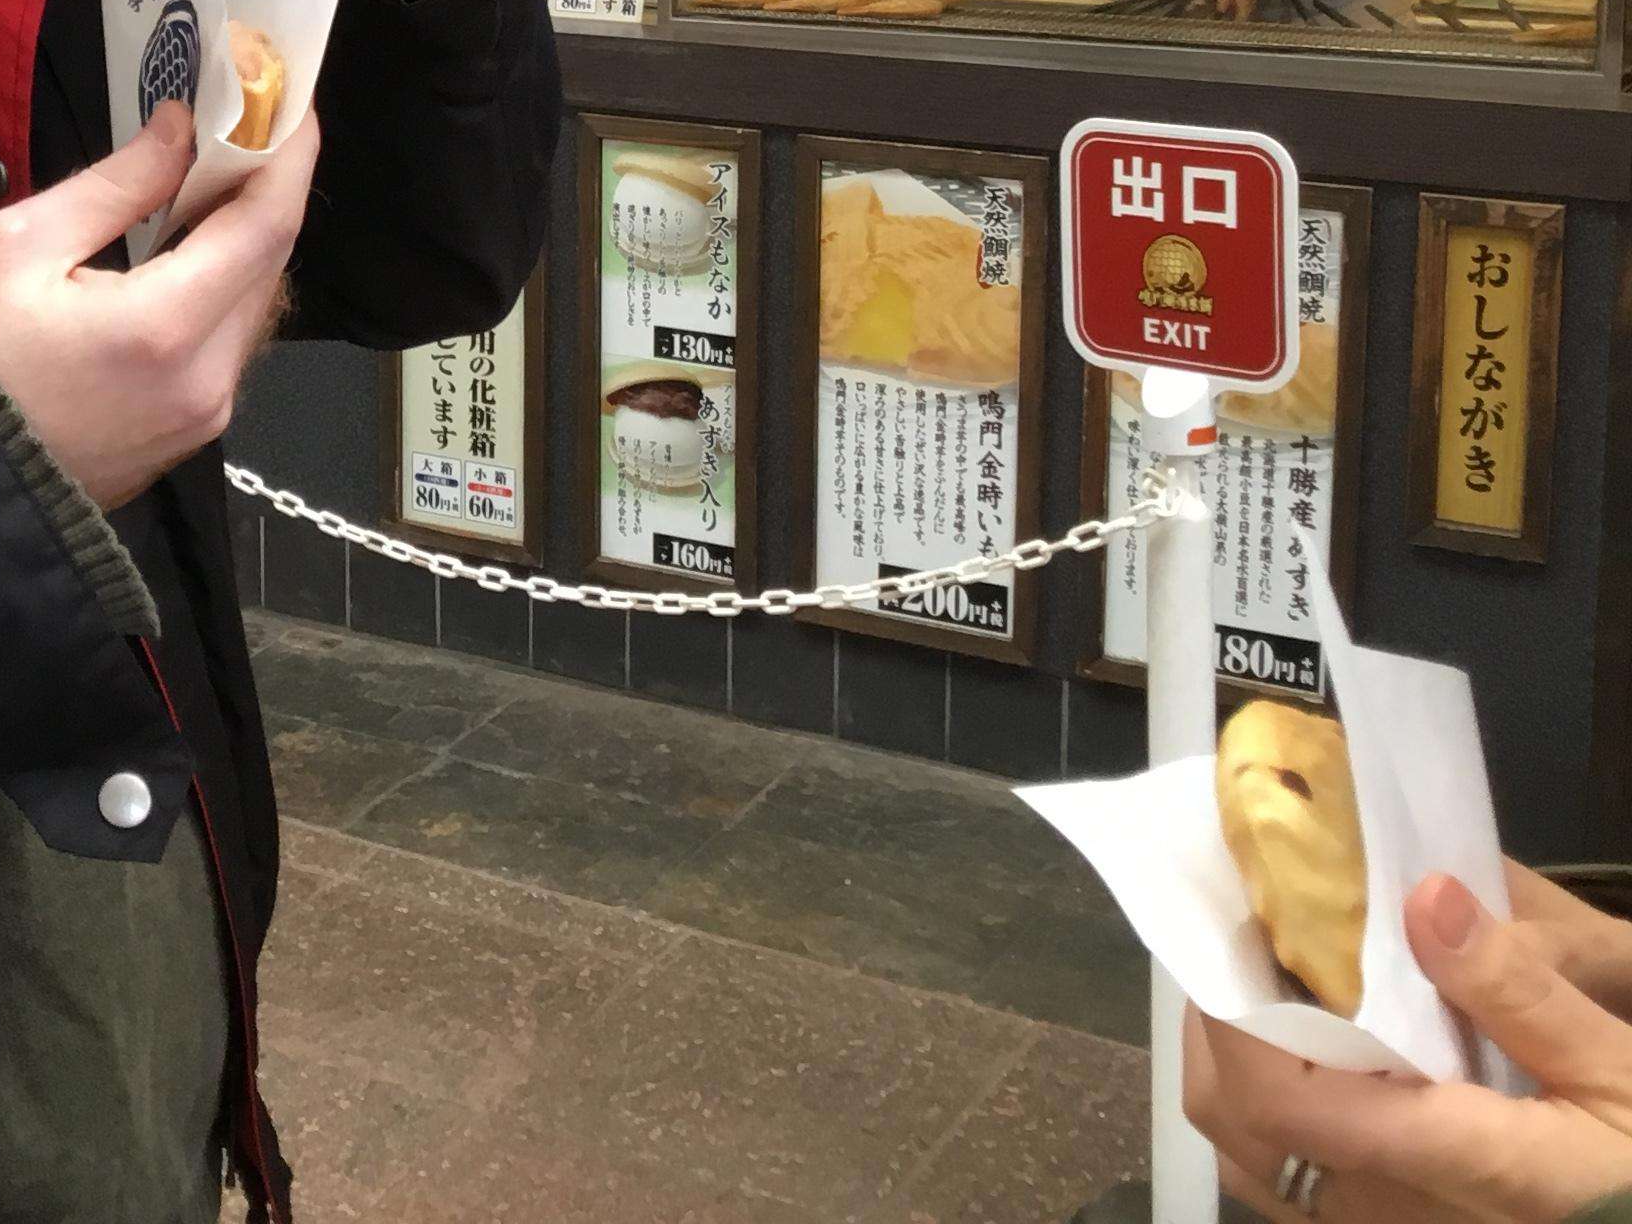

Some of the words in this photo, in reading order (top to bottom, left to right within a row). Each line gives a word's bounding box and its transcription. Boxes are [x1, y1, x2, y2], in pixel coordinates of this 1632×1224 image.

[707, 163, 732, 320] アイスもなか
[983, 187, 1010, 285] 天然鯛焼
[1111, 156, 1237, 229] 出口
[1298, 218, 1327, 324] 天然鯛焼
[1143, 317, 1211, 351] EXIT
[1459, 244, 1512, 493] おしながき
[698, 396, 722, 531] あずき入り
[977, 389, 1006, 559] 鳴門金時いも
